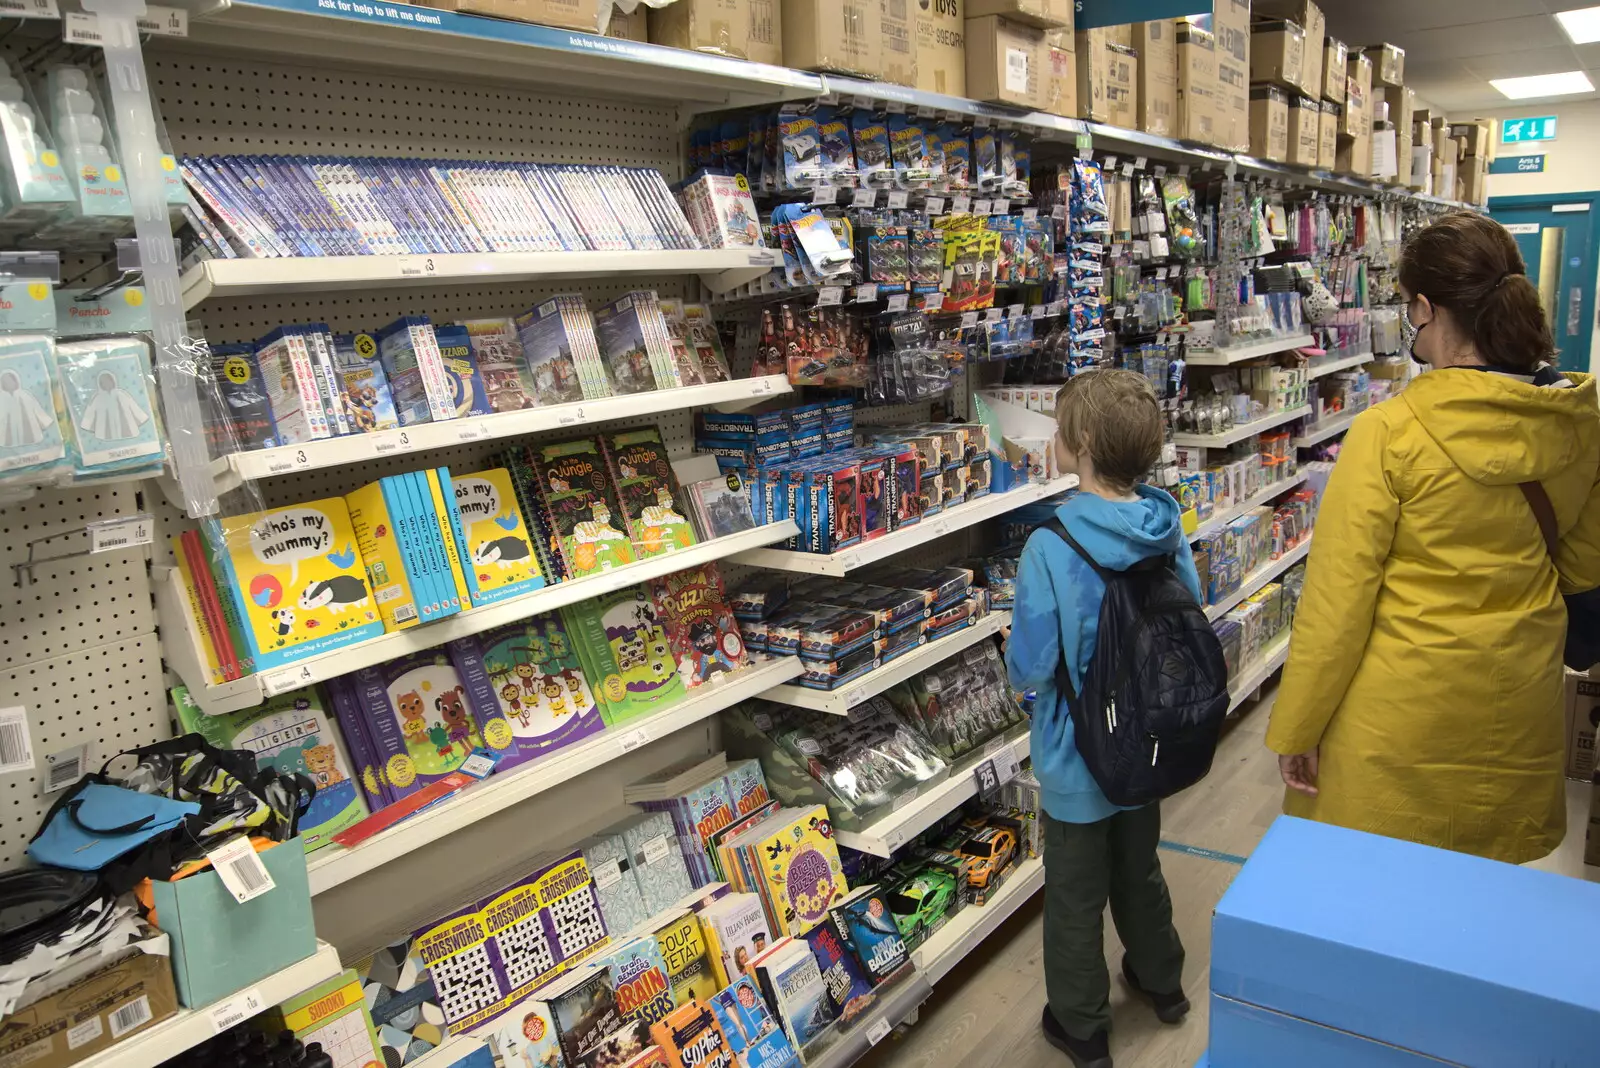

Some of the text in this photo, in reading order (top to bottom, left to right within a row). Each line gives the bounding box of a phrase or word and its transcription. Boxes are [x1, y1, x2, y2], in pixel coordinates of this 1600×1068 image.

[318, 0, 441, 25] Ask for help to lift me down!
[934, 0, 957, 17] TOYS
[359, 340, 373, 354] €3
[228, 366, 246, 379] €3
[558, 462, 593, 477] Jungle
[627, 451, 658, 464] Jungle
[474, 484, 491, 496] my
[811, 486, 820, 551] TRANBOT-360
[827, 475, 835, 536] TRANBOT-360
[258, 514, 325, 541] Who's my
[262, 531, 329, 560] mummy?
[666, 572, 707, 596] MEGA
[408, 723, 421, 731] Cat
[319, 773, 328, 782] W
[980, 769, 996, 790] 25
[703, 795, 718, 806] Brain
[737, 783, 768, 816] BRAIN
[697, 803, 735, 844] BRAIN
[540, 878, 549, 887] THE
[549, 871, 564, 883] GREAT
[564, 866, 576, 877] BOOK
[790, 853, 819, 884] Brain
[539, 866, 589, 903] CROSSWORDS
[485, 893, 539, 933] CROSSWORDS
[486, 888, 532, 916] THE GREAT BOOK OF
[421, 917, 475, 947] THE GREAT BOOK OF
[830, 910, 849, 941] BALDACCI
[420, 923, 485, 965] CROSSWORDS
[867, 939, 907, 973] BALDACCI
[872, 935, 895, 954] DAVID
[618, 960, 651, 982] BENDERS
[620, 957, 643, 973] Brain
[684, 962, 702, 977] COES
[615, 966, 667, 1015] BRAIN
[783, 969, 819, 999] PILCHER
[830, 972, 851, 999] COLLINS
[308, 991, 346, 1022] SUDOKU
[462, 1016, 474, 1027] OVER
[486, 1000, 507, 1016] PUZZLES
[758, 1041, 777, 1061] MRS.
